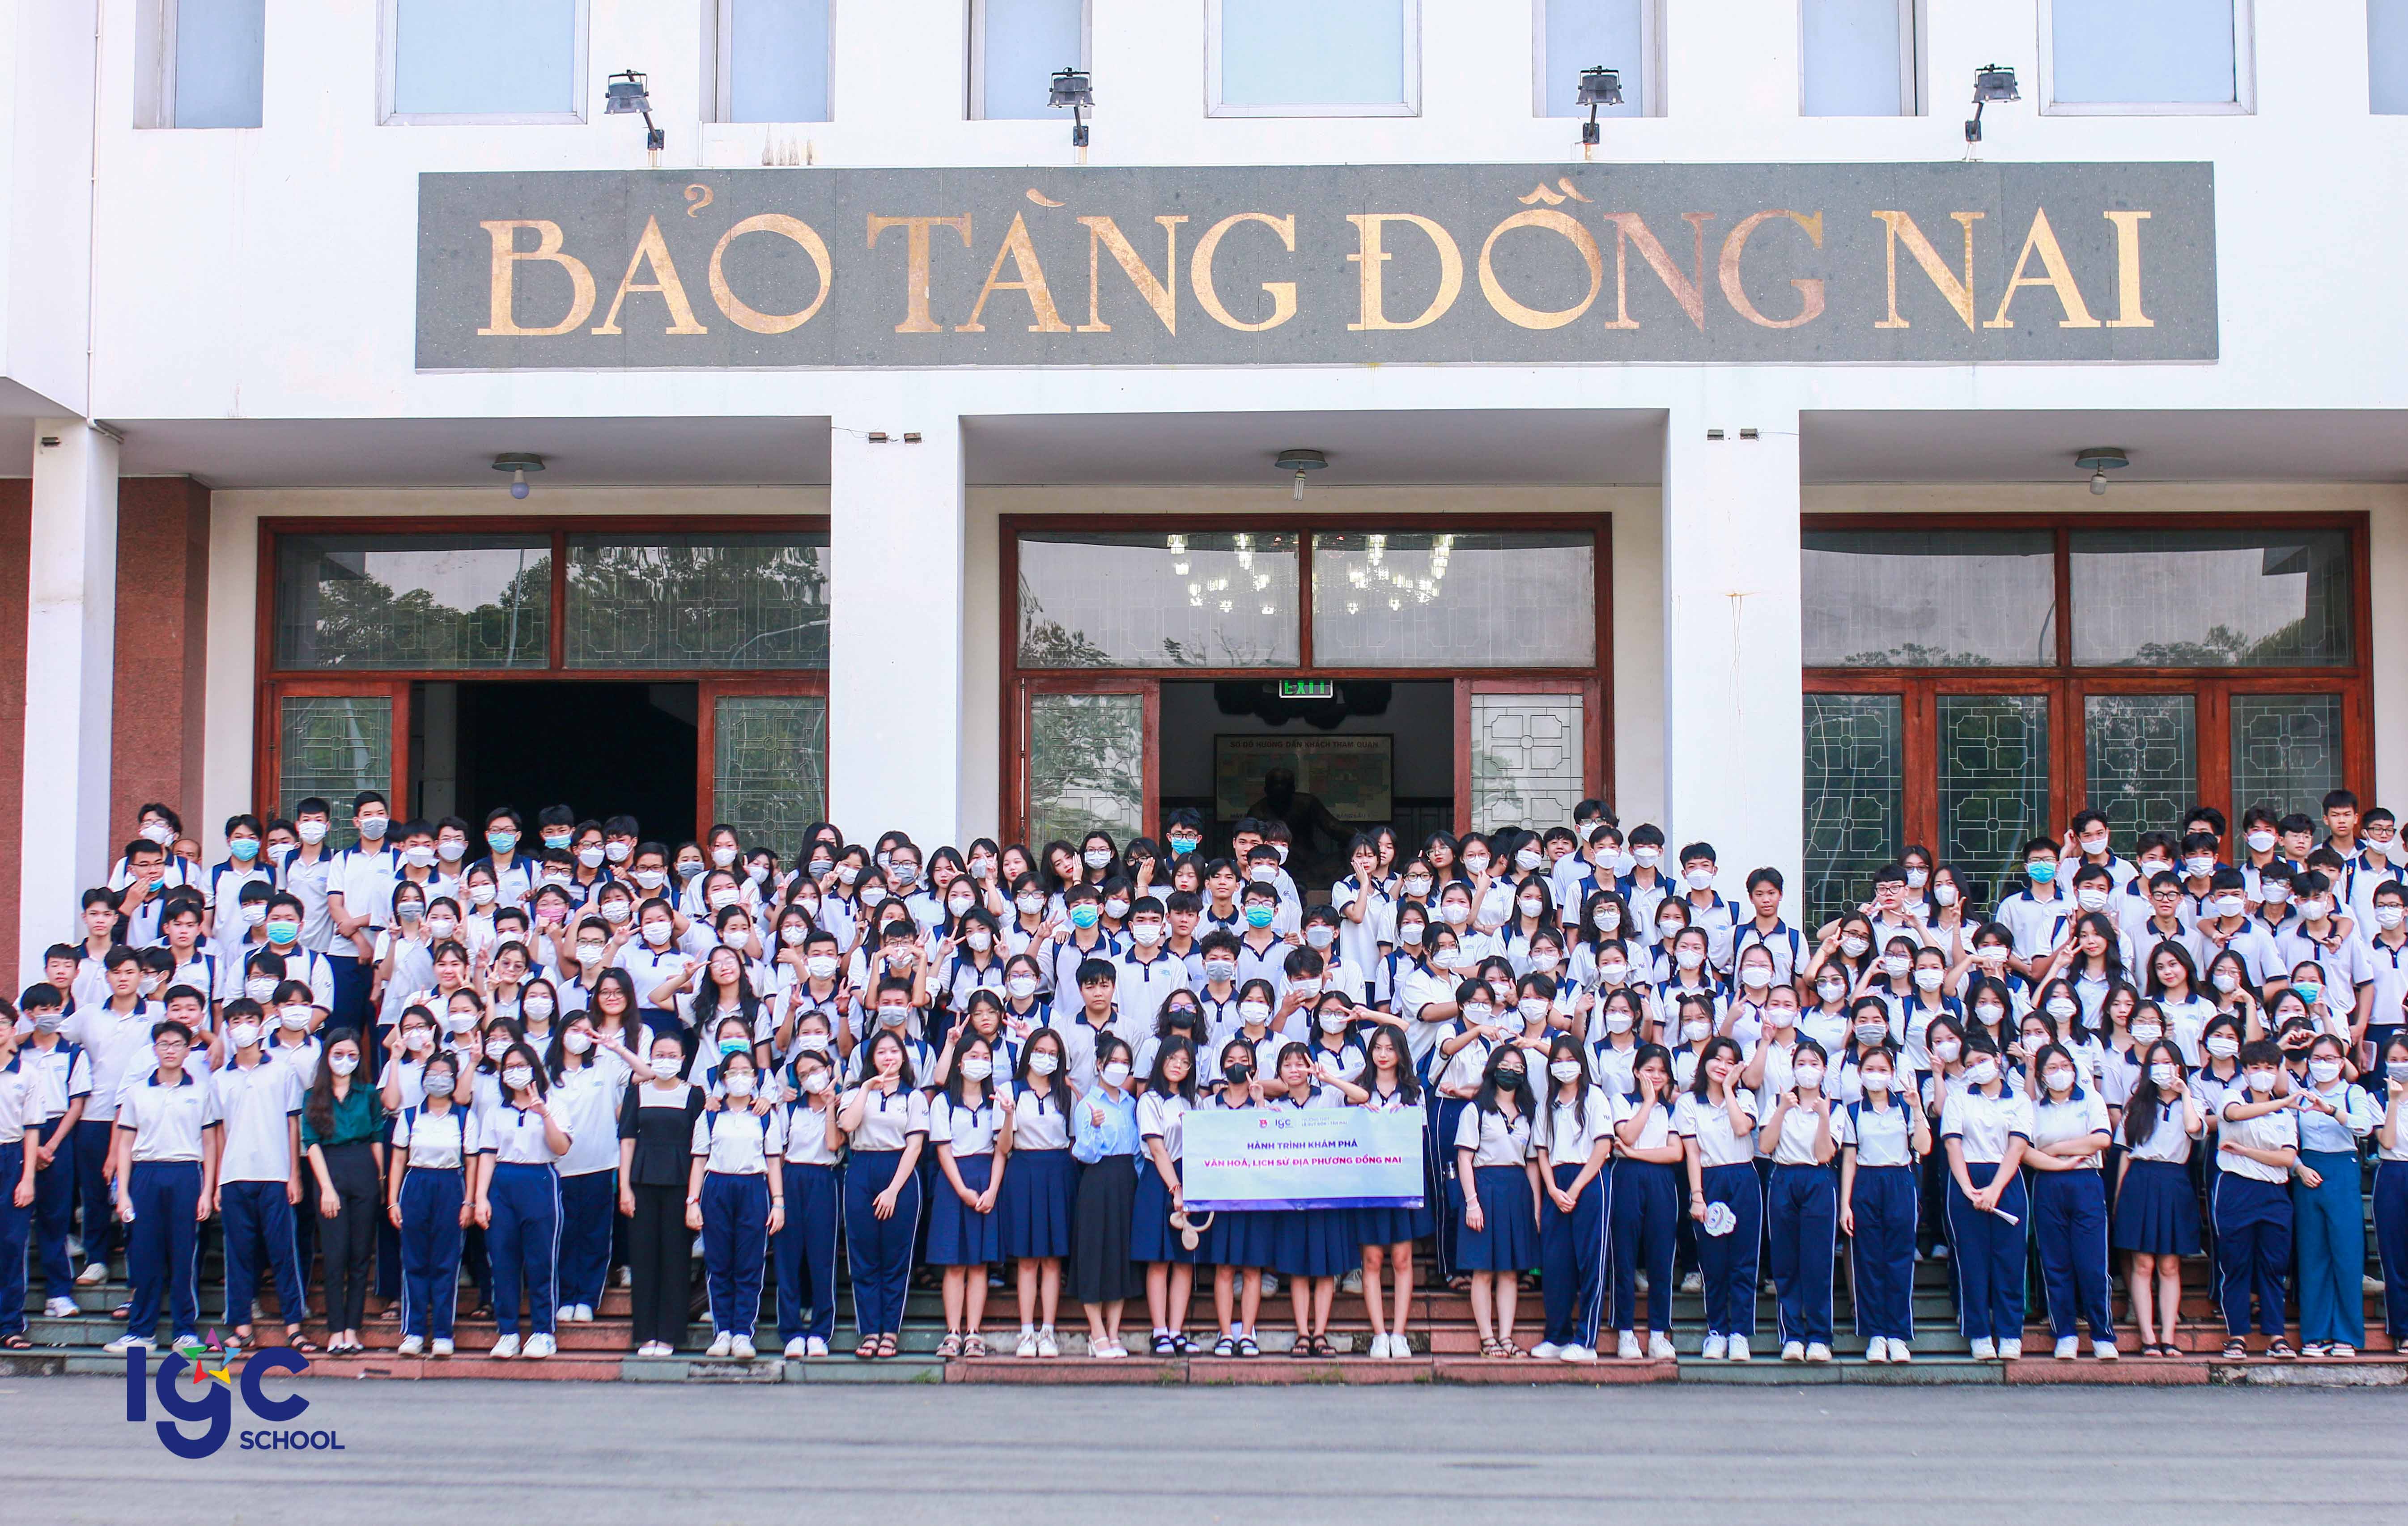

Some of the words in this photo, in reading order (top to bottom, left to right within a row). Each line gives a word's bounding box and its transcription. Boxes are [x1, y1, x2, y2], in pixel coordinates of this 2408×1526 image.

[477, 183, 832, 335] BẢO
[866, 187, 1298, 338] TÀNG
[1346, 177, 1826, 334] ĐỒNG
[1872, 206, 2155, 334] NAI
[1247, 1140, 1274, 1149] HÀNH
[1277, 1140, 1305, 1149] TRÌNH
[1308, 1139, 1336, 1149] KHÁM
[1338, 1138, 1358, 1148] PHÁ
[1204, 1158, 1224, 1167] VĂN
[1253, 1159, 1274, 1169] LỊCH
[1277, 1156, 1290, 1166] SỬ
[1292, 1158, 1309, 1167] ĐỊA
[1312, 1156, 1353, 1165] PHƯƠNG
